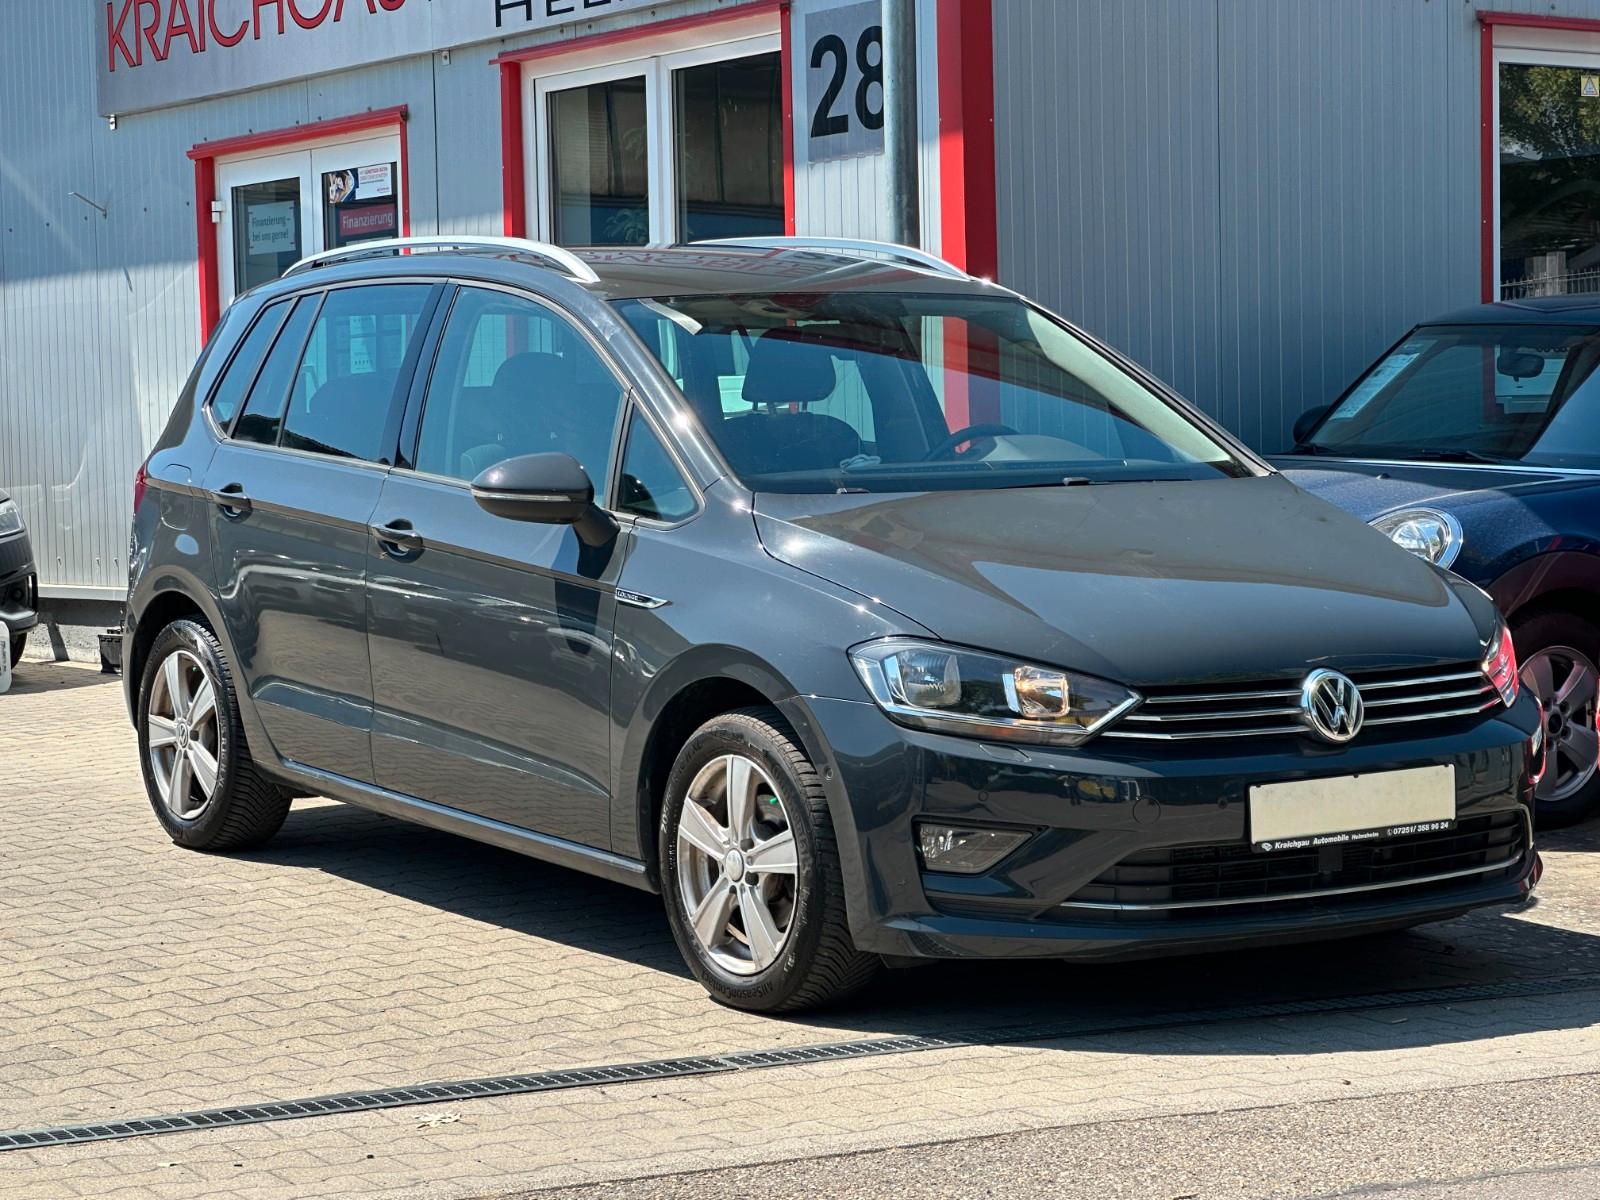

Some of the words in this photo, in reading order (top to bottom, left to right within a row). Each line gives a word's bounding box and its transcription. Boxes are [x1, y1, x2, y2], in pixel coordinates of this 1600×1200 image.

[106, 0, 405, 72] KRAICH
[810, 26, 884, 138] 28
[342, 211, 393, 229] Finanzierung
[1274, 840, 1310, 850] Kraichgau
[1312, 833, 1350, 846] Automobile
[1392, 825, 1417, 836] 07251/
[1440, 821, 1449, 830] 24
